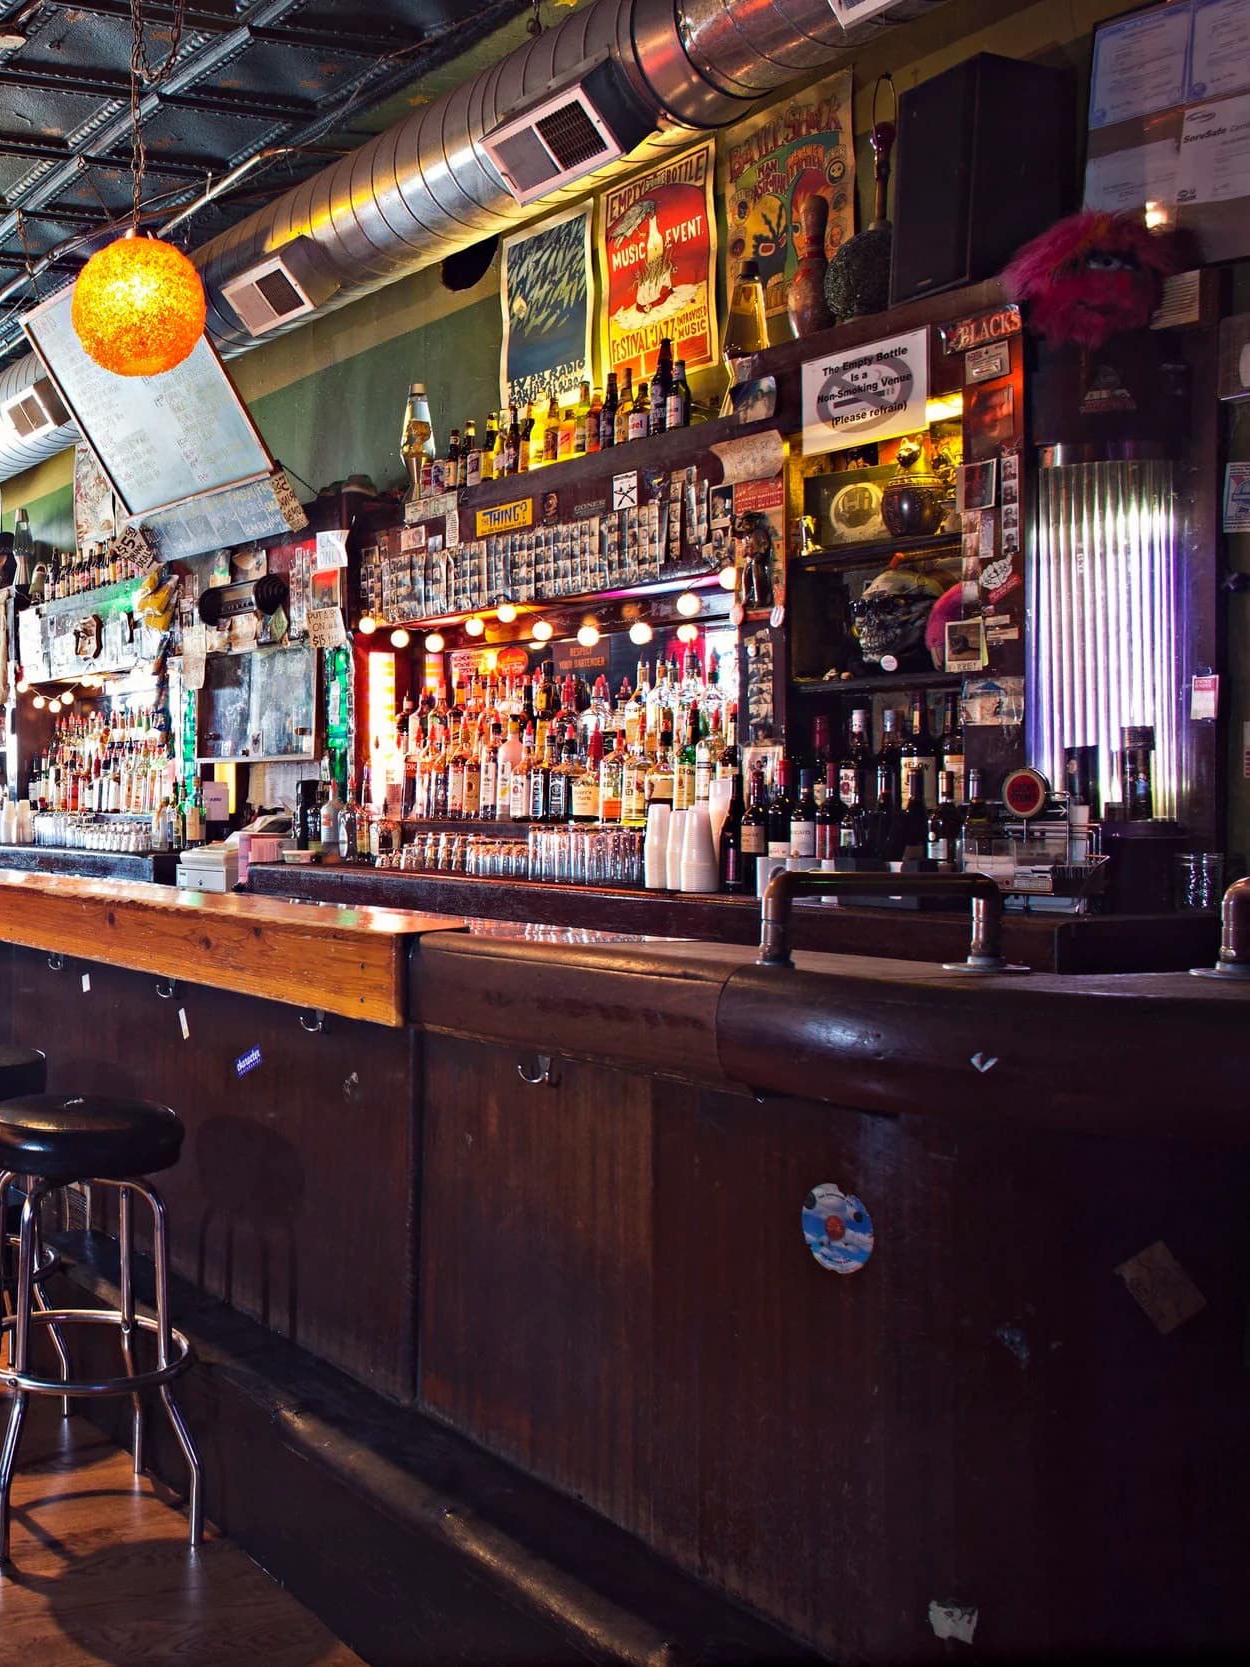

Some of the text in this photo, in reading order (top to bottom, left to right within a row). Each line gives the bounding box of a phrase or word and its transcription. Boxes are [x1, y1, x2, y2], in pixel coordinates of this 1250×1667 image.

[611, 155, 705, 221] EMPTY BOTTLE
[612, 242, 646, 272] MUSIC
[612, 326, 651, 362] FESTIVAL
[678, 319, 707, 339] MUSIC
[958, 311, 1022, 348] BLACKS
[822, 346, 908, 377] The Empty Bottle
[817, 373, 912, 404] Non-Smoking Venue
[831, 401, 908, 428] (Please refrain)
